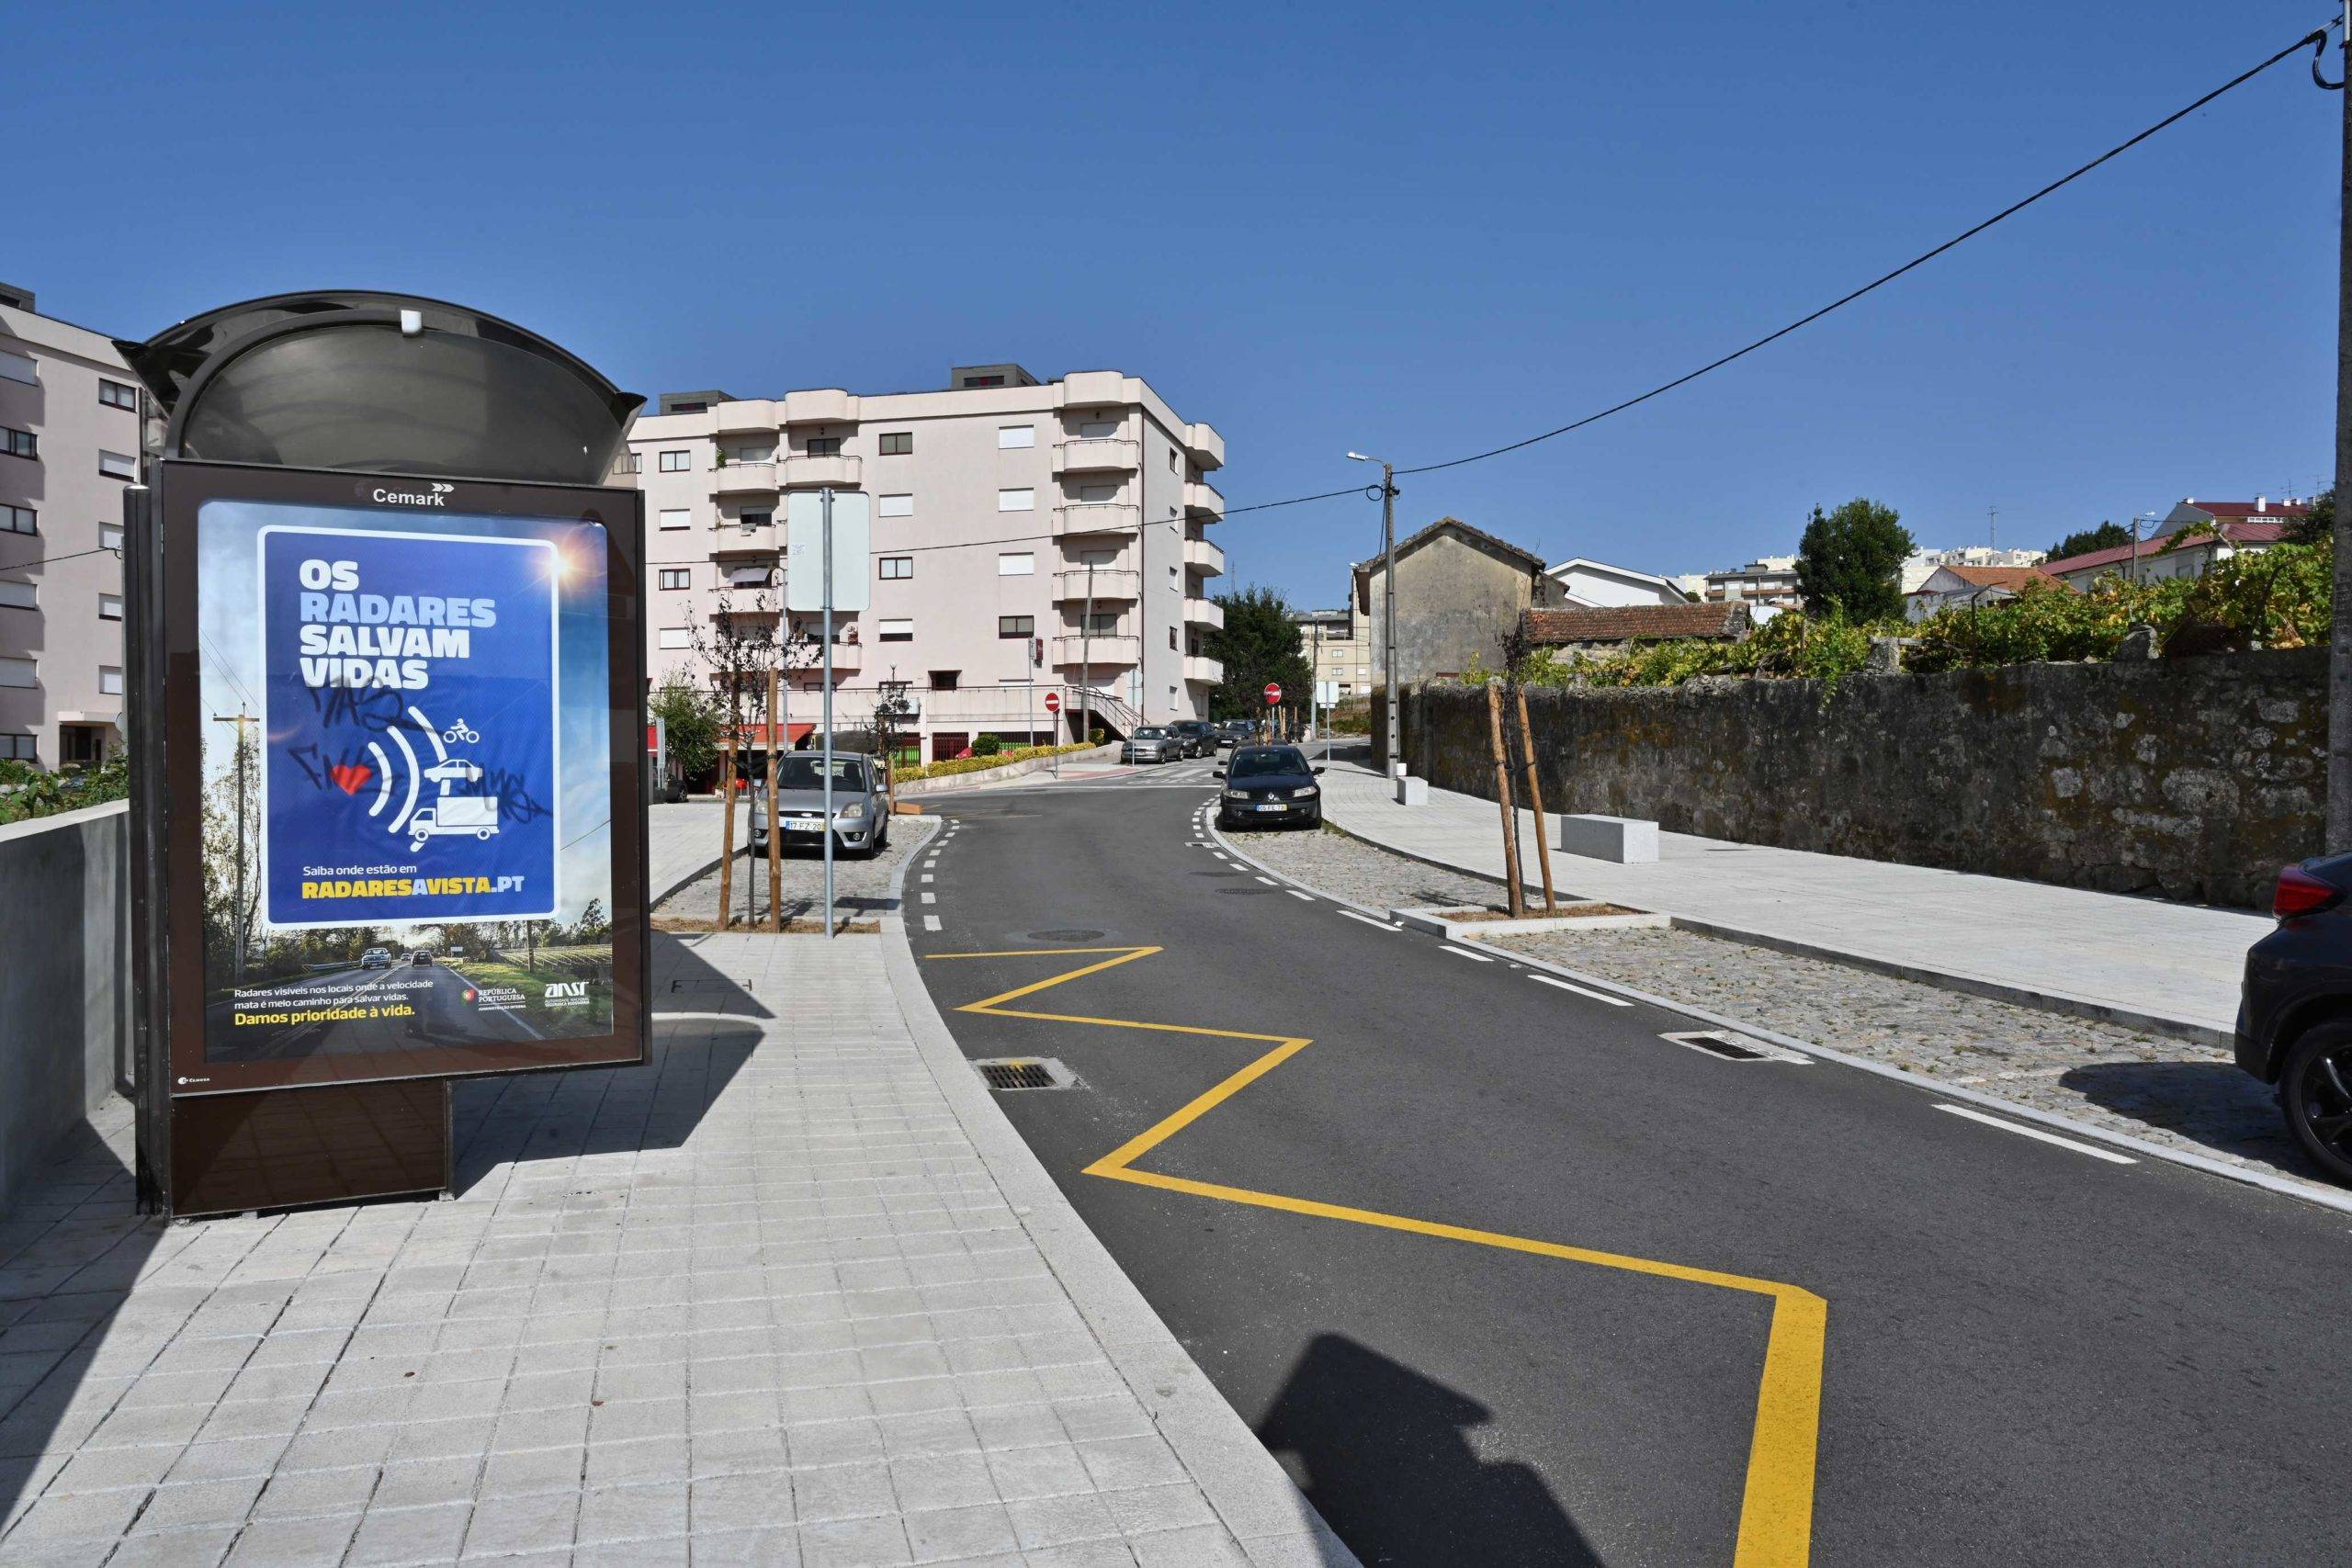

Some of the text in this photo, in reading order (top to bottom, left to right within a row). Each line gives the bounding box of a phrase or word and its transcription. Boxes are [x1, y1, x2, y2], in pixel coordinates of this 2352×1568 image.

[373, 488, 445, 506] Cemark
[300, 558, 359, 591] OS
[300, 592, 497, 628] RADARES
[300, 625, 470, 659] SALVAM
[300, 657, 429, 690] VIDAS
[303, 864, 417, 876] Saiba onde estão em
[301, 875, 525, 899] RADARESAVISTA.PT
[234, 989, 273, 998] Radares
[275, 987, 308, 996] visíveis
[328, 985, 354, 993] locais
[355, 983, 379, 991] onde
[387, 980, 434, 990] velocidade
[479, 994, 526, 1002] PORTUGUESA
[234, 993, 409, 1010] mata é meio caminho para salvar vidas.
[234, 1004, 415, 1026] Damos prioridade à vida.
